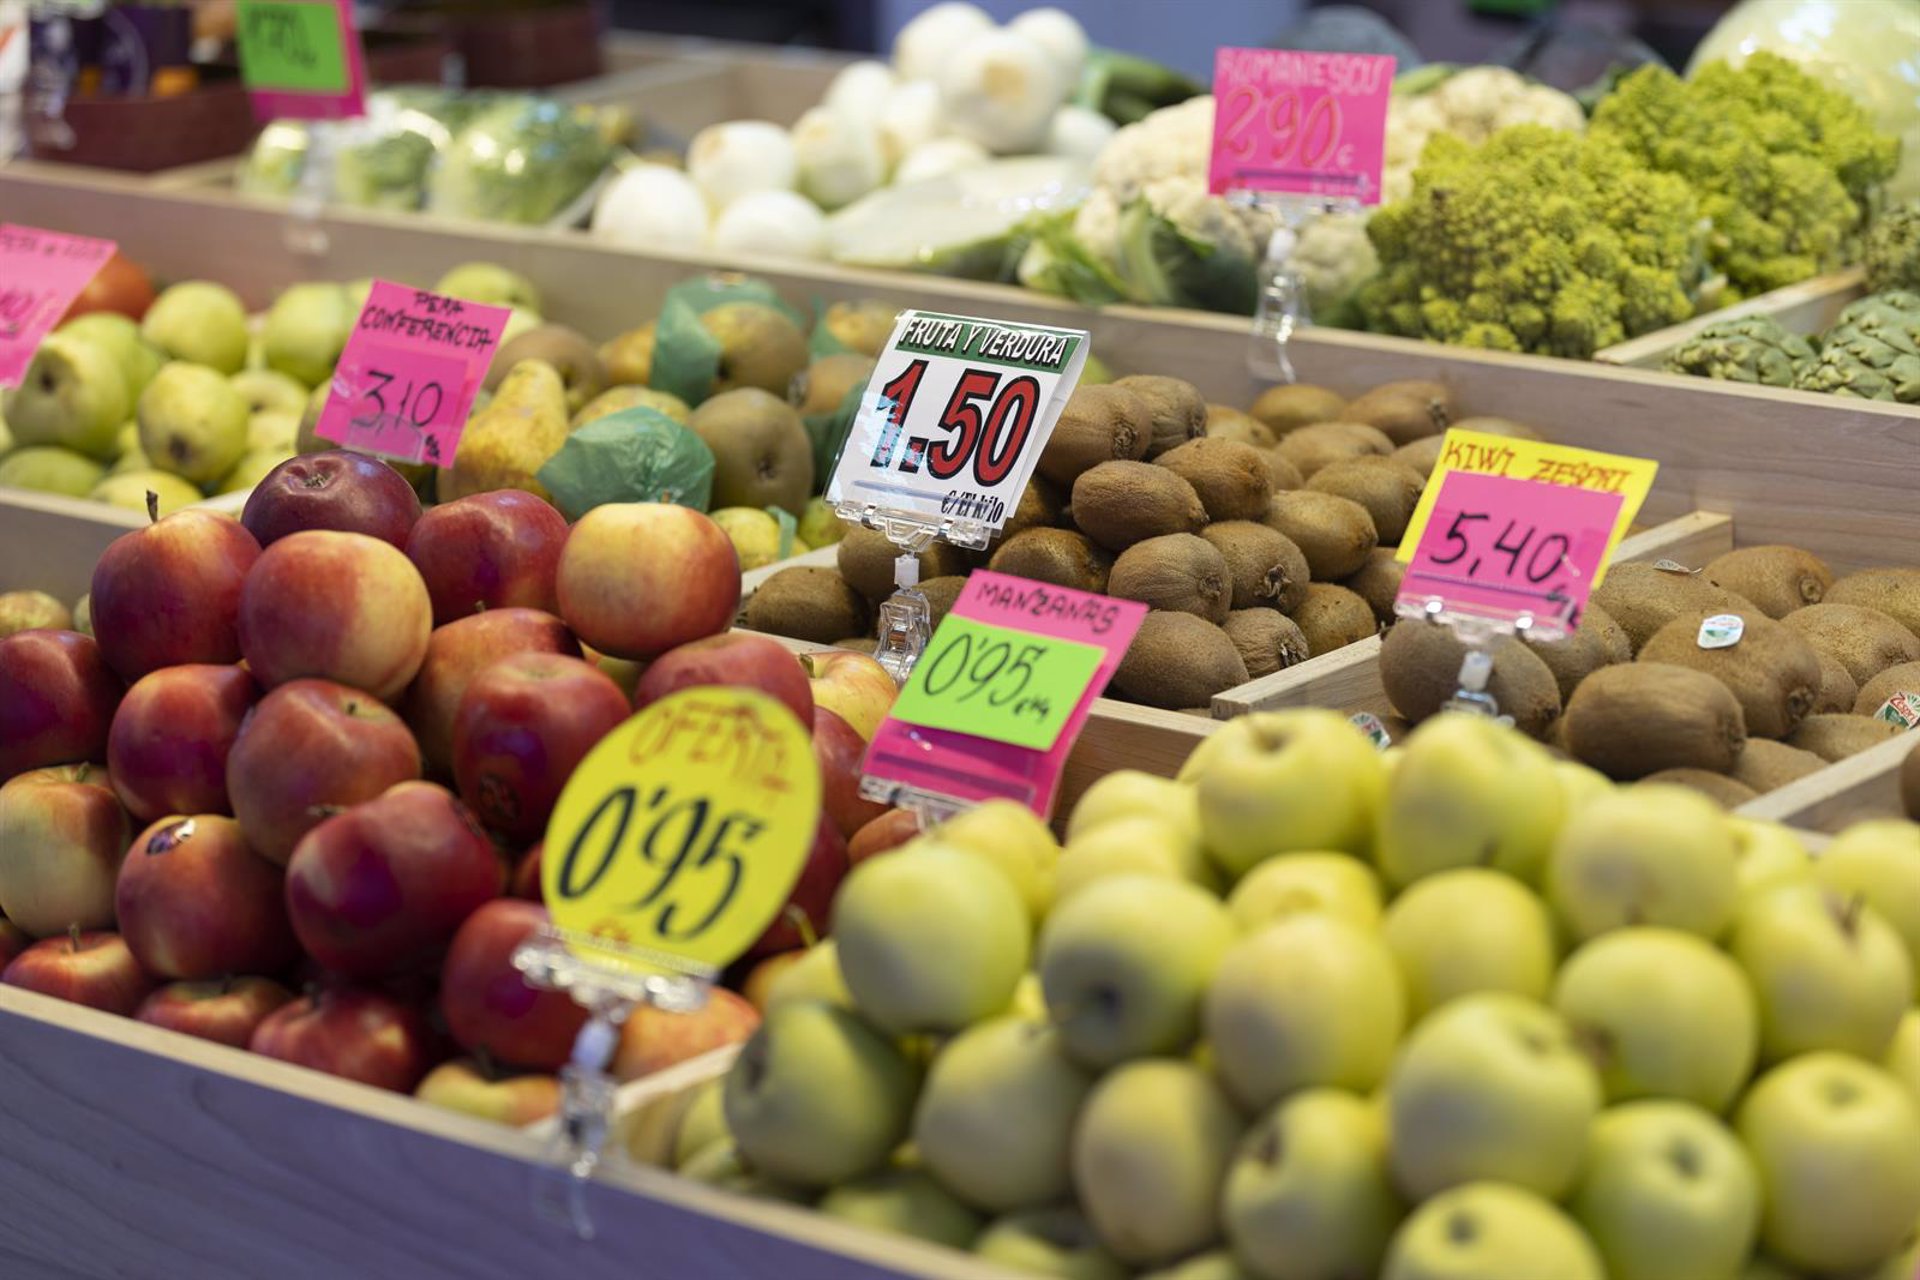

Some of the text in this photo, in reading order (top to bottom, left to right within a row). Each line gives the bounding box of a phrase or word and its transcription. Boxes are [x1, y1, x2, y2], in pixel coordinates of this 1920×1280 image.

[360, 305, 494, 355] CONFERENCIA
[899, 317, 1070, 367] FRUTA Y VERDURA
[350, 368, 444, 437] 3,10
[869, 358, 1040, 488] 1.50
[1442, 440, 1634, 494] KIWI ZESPRI
[1429, 510, 1570, 584] 5,40
[977, 582, 1122, 634] MANZANAS
[629, 700, 792, 794] OFERTA
